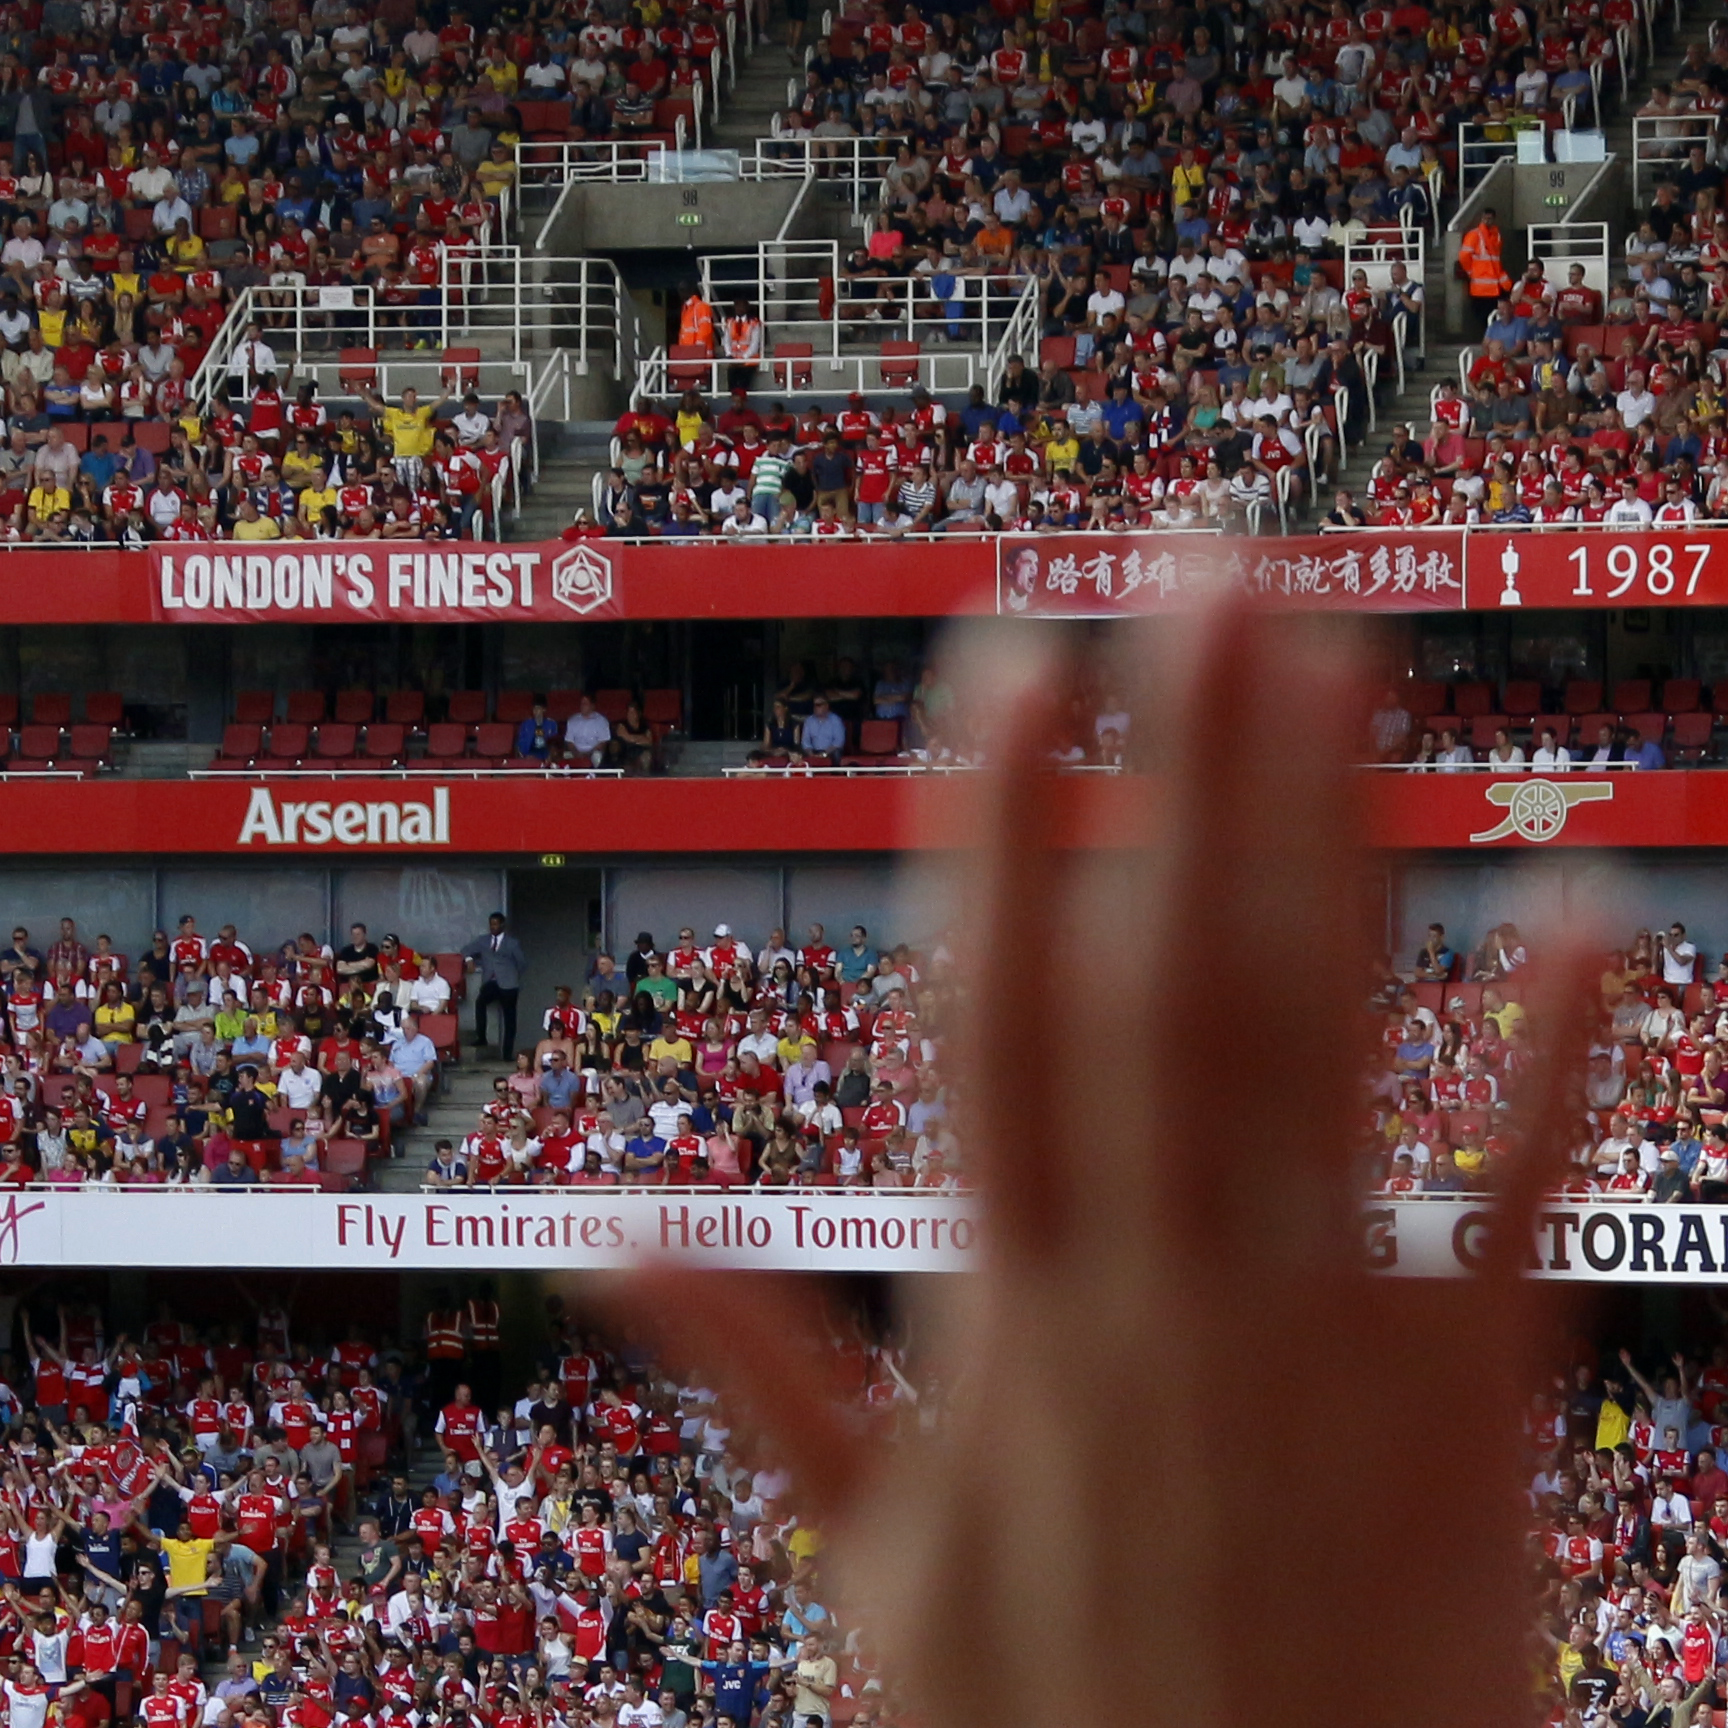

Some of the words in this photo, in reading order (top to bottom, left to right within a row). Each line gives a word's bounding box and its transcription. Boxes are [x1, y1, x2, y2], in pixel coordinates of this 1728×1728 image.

[683, 189, 698, 206] 98
[1550, 170, 1565, 188] 99
[160, 552, 374, 609] LONDON'S
[387, 551, 540, 608] FINEST
[1567, 543, 1713, 597] 1987
[237, 786, 450, 844] Arsenal
[335, 1203, 407, 1259] Fly
[658, 1204, 773, 1250] Hello
[785, 1204, 975, 1251] Tomorro
[722, 1680, 741, 1690] JVC
